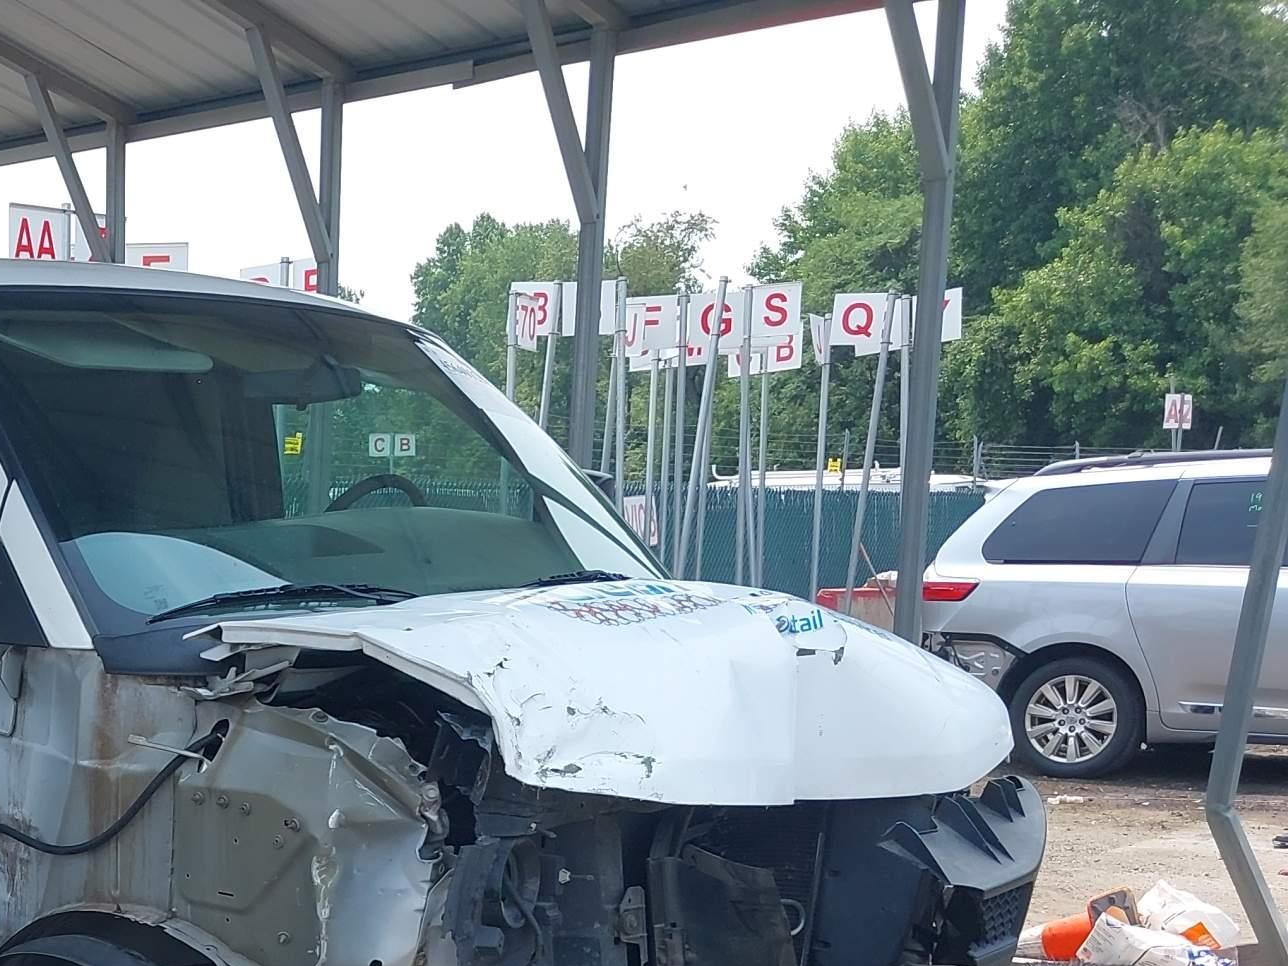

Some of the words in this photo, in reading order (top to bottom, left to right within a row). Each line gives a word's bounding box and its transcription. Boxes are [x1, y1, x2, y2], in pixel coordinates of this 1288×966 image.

[15, 217, 55, 260] AA
[520, 304, 536, 341] 70
[700, 303, 733, 337] G
[763, 292, 788, 327] S
[842, 302, 874, 338] Q
[373, 437, 386, 453] C
[399, 437, 411, 452] B
